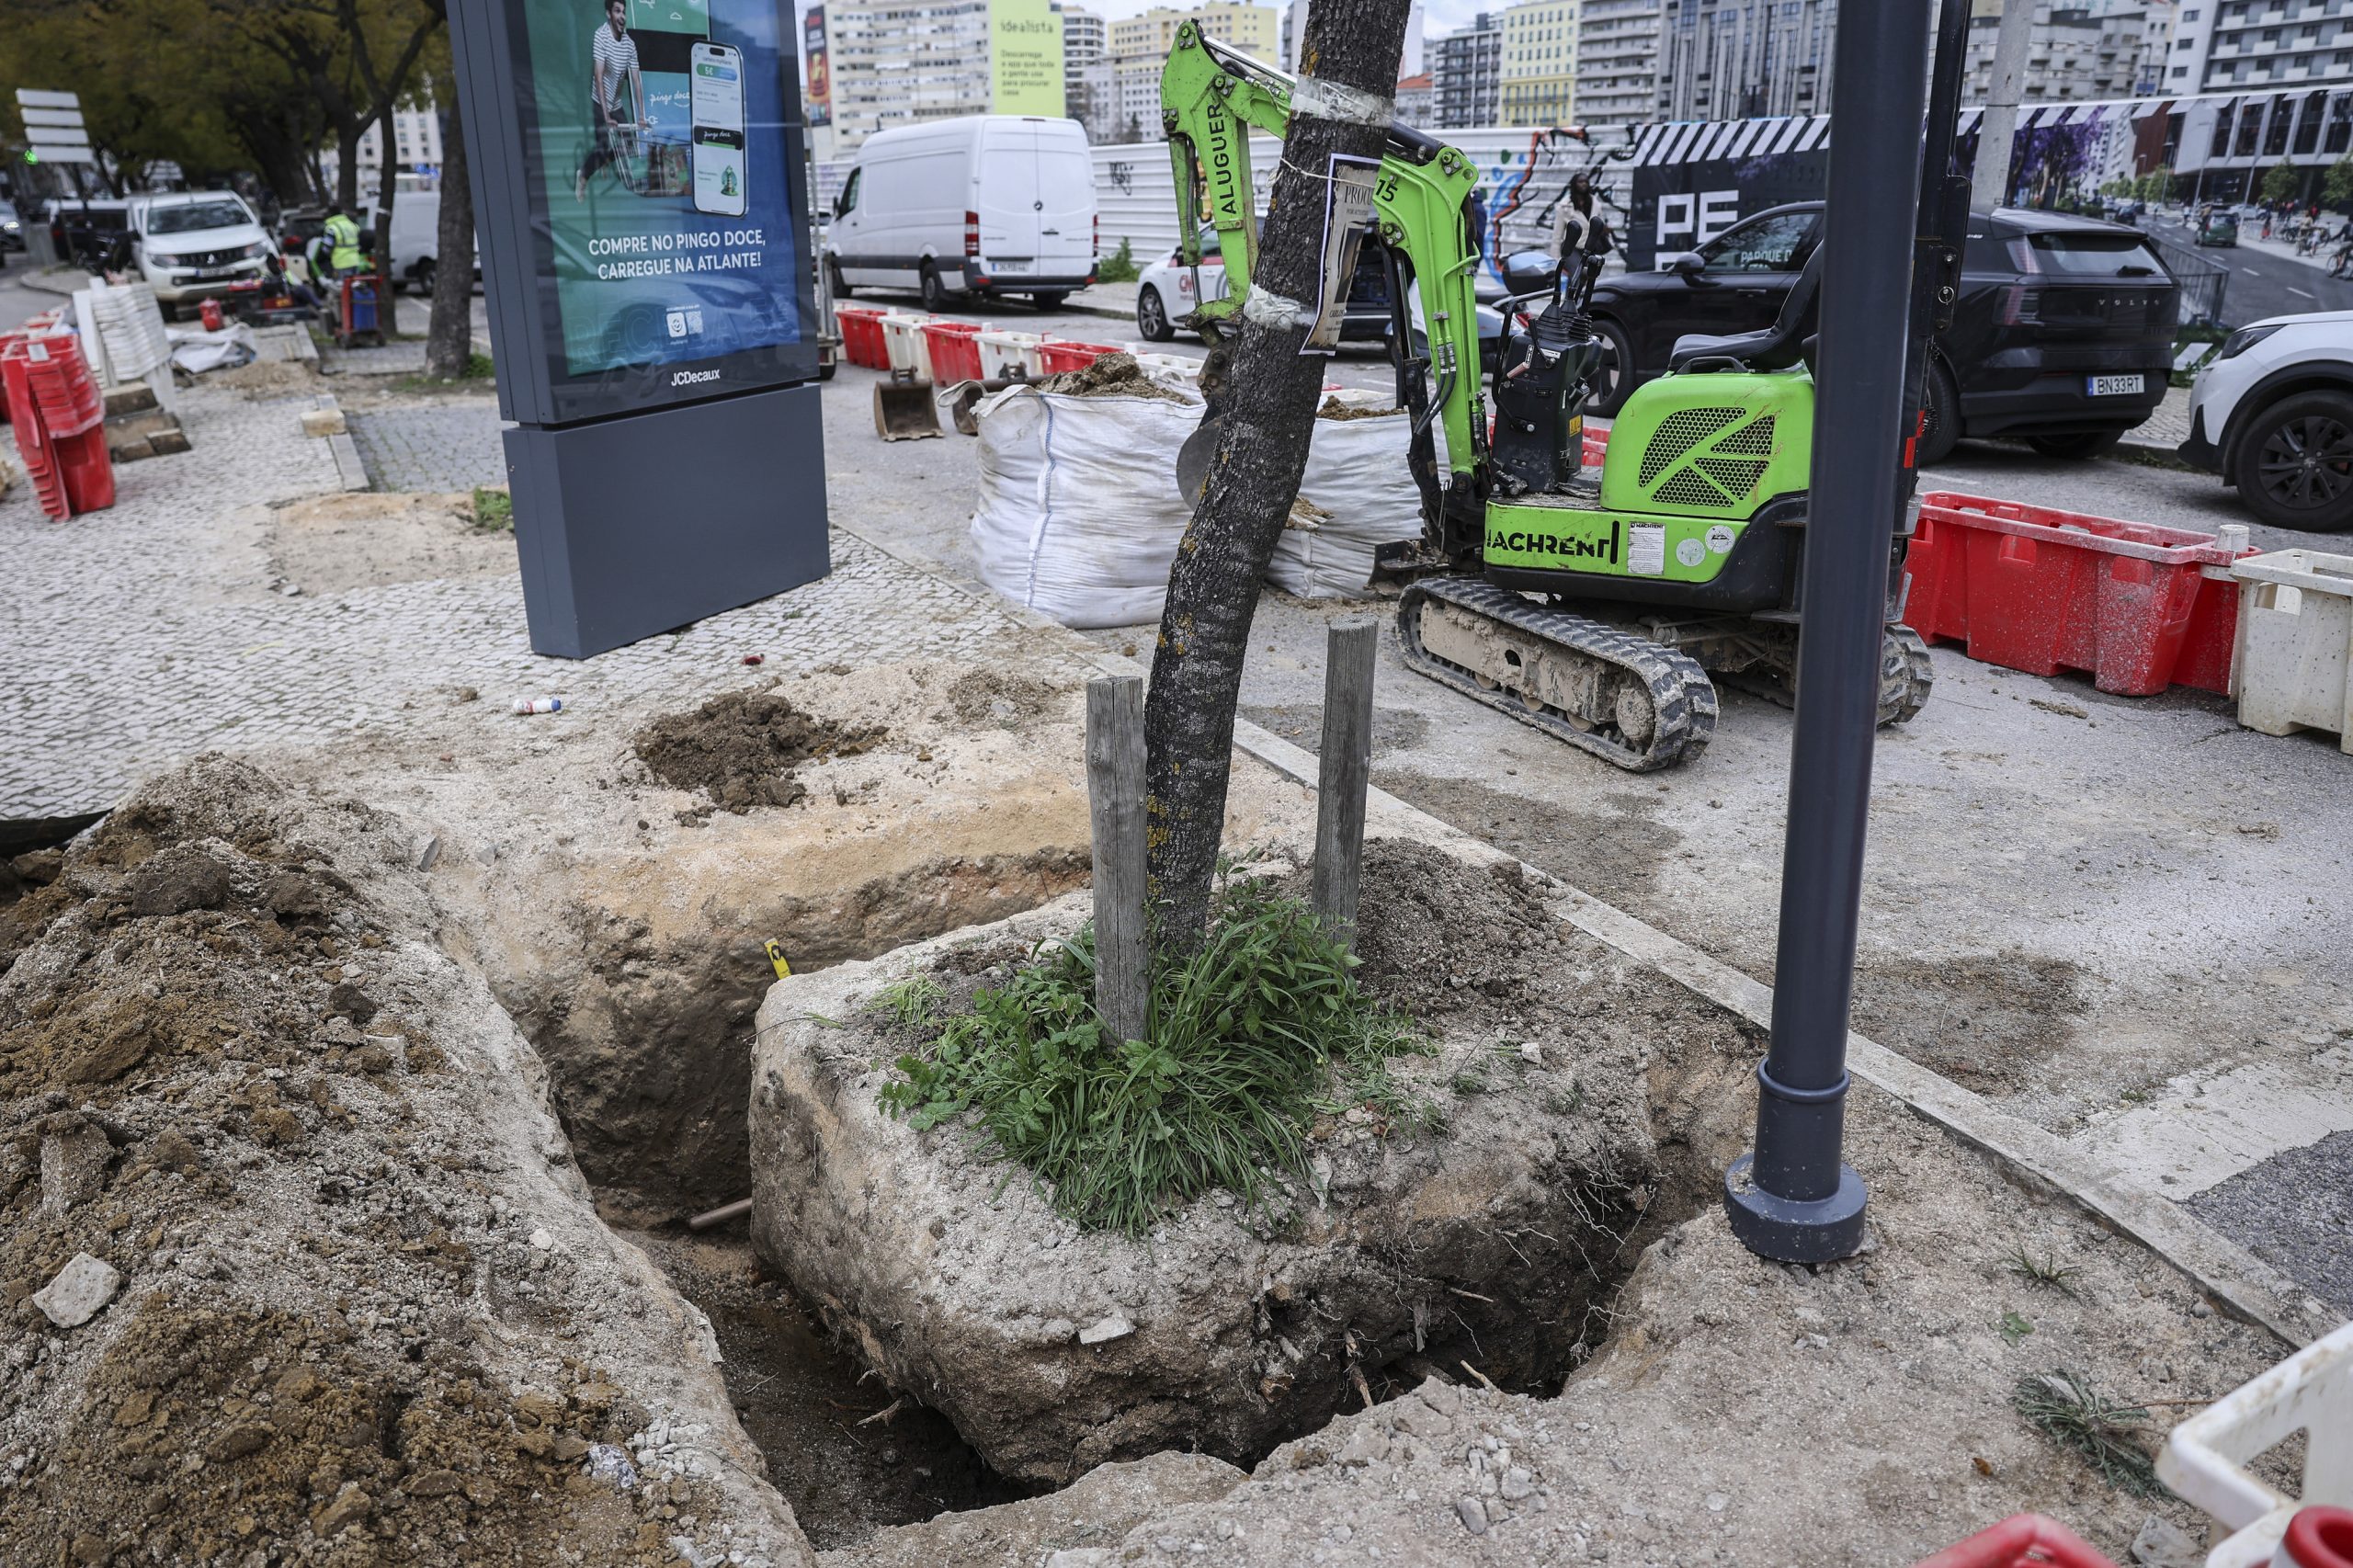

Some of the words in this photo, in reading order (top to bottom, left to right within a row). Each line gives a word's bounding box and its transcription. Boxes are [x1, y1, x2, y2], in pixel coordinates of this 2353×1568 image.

[1000, 20, 1054, 33] idealista
[1207, 100, 1237, 215] ALUGUER
[588, 235, 648, 256] COMPRE
[652, 234, 673, 251] NO
[676, 231, 721, 249] PINGO
[724, 229, 766, 246] DOCE,
[598, 257, 672, 279] CARREGUE
[675, 256, 694, 273] NA
[698, 251, 762, 271] ATLANTE!
[671, 369, 721, 386] JCDecaux
[2097, 376, 2140, 394] BN33RT
